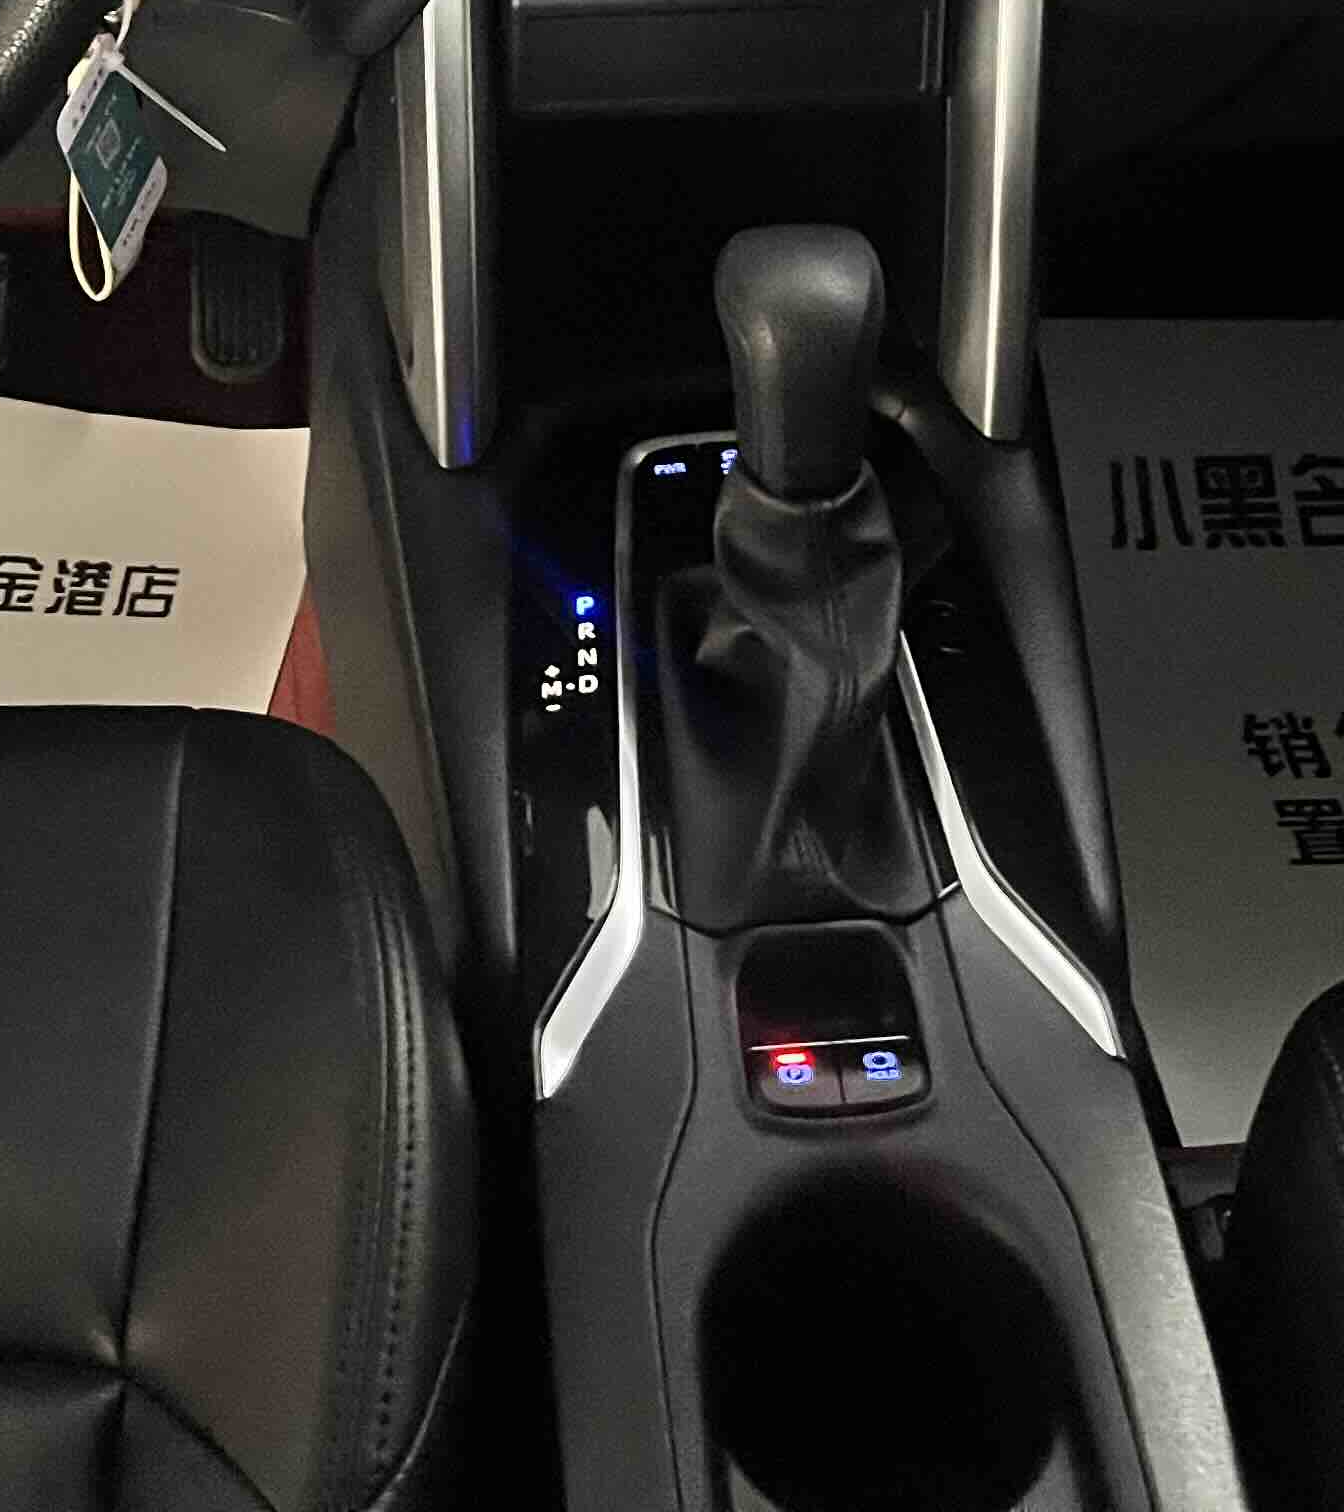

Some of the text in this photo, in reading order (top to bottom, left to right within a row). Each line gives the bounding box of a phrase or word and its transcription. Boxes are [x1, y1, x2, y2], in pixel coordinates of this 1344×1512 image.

[576, 596, 595, 616] P
[577, 621, 597, 641] R
[577, 648, 598, 667] N
[541, 680, 563, 700] M
[578, 675, 599, 694] D
